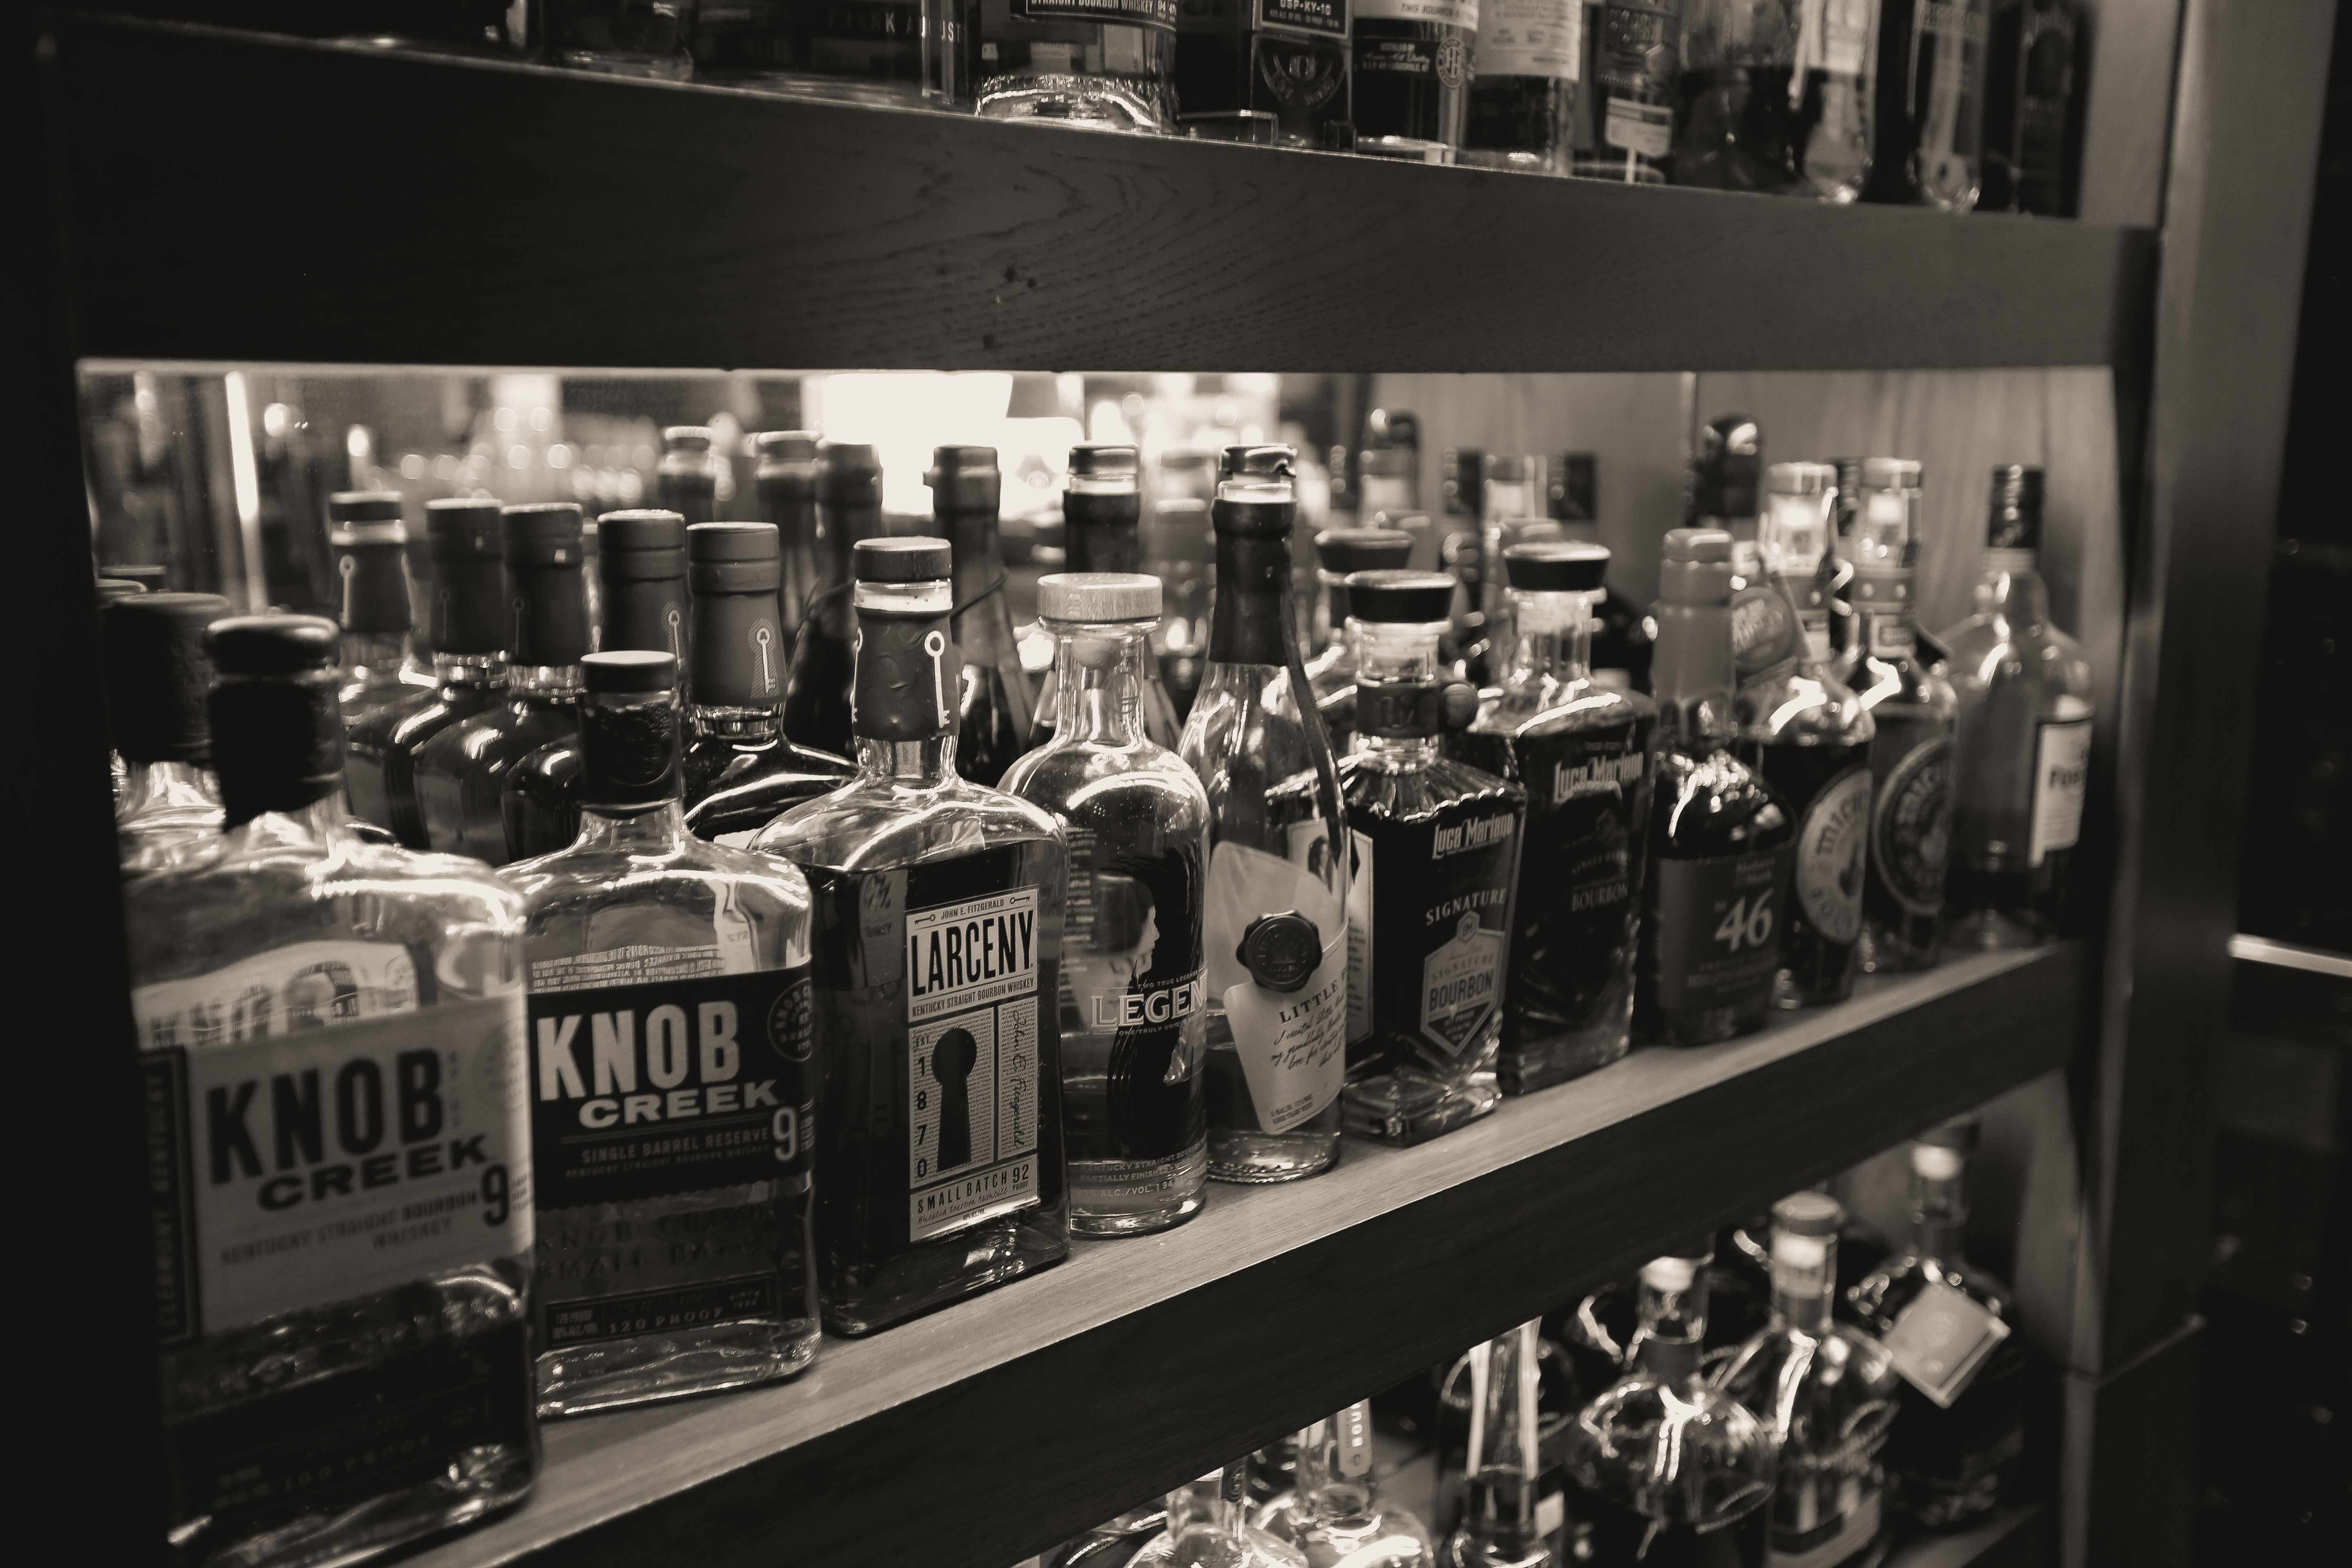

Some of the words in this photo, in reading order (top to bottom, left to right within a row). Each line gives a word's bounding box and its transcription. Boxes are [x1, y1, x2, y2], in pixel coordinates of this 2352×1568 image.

[1432, 822, 1462, 860] Luca
[1461, 813, 1514, 847] Mariano
[940, 909, 958, 920] JOHN
[960, 907, 966, 915] E.
[967, 899, 1004, 914] FITZGERALD
[1425, 888, 1507, 926] SIGNATURE
[1571, 883, 1628, 913] BOURBON
[1714, 886, 1775, 953] 46
[911, 910, 1034, 996] LARCENY
[912, 1001, 945, 1017] KENTUCKY
[946, 992, 976, 1008] STRAIGHT
[978, 984, 1006, 1001] BOURBON
[1007, 977, 1034, 993] WHISKEY
[1091, 968, 1208, 1028] LEGEN
[1157, 978, 1174, 987] TRUE
[1278, 979, 1338, 1025] LITTLE
[1429, 969, 1493, 1012] BOURBON
[1119, 1028, 1136, 1036] ONE
[1138, 1025, 1162, 1035] TRULY
[537, 1000, 740, 1102] KNOB
[205, 1049, 443, 1185] KNOB
[579, 1079, 779, 1129] CREEK
[581, 1143, 638, 1165] SINGLE
[642, 1136, 700, 1157] BARREL
[705, 1127, 769, 1149] RESERVE
[772, 1106, 798, 1163] 9
[256, 1134, 487, 1210] CREEK
[565, 1164, 619, 1179] KENTUCKY
[622, 1157, 672, 1172] STRAIGHT
[675, 1150, 723, 1165] BOURBON
[726, 1143, 769, 1158] WHISKEY
[1012, 1164, 1029, 1183] 92
[1080, 1163, 1132, 1172] KENTUCKY
[1134, 1154, 1175, 1169] STRAIGHT
[1080, 1173, 1130, 1182] PARTIALLY
[1130, 1166, 1168, 1180] FINISHED
[481, 1163, 509, 1226] 9
[917, 1186, 961, 1214] SMALL
[966, 1170, 1007, 1197] BATCH
[1012, 1180, 1029, 1192] PROOF
[949, 1200, 976, 1213] Bourbon
[220, 1229, 313, 1266] KENTUCKY
[317, 1208, 396, 1244] STRAIGHT
[401, 1189, 477, 1223] BOURBON
[371, 1215, 454, 1250] WHISKEY
[608, 1317, 647, 1334] 120
[655, 1306, 724, 1328] PROOF
